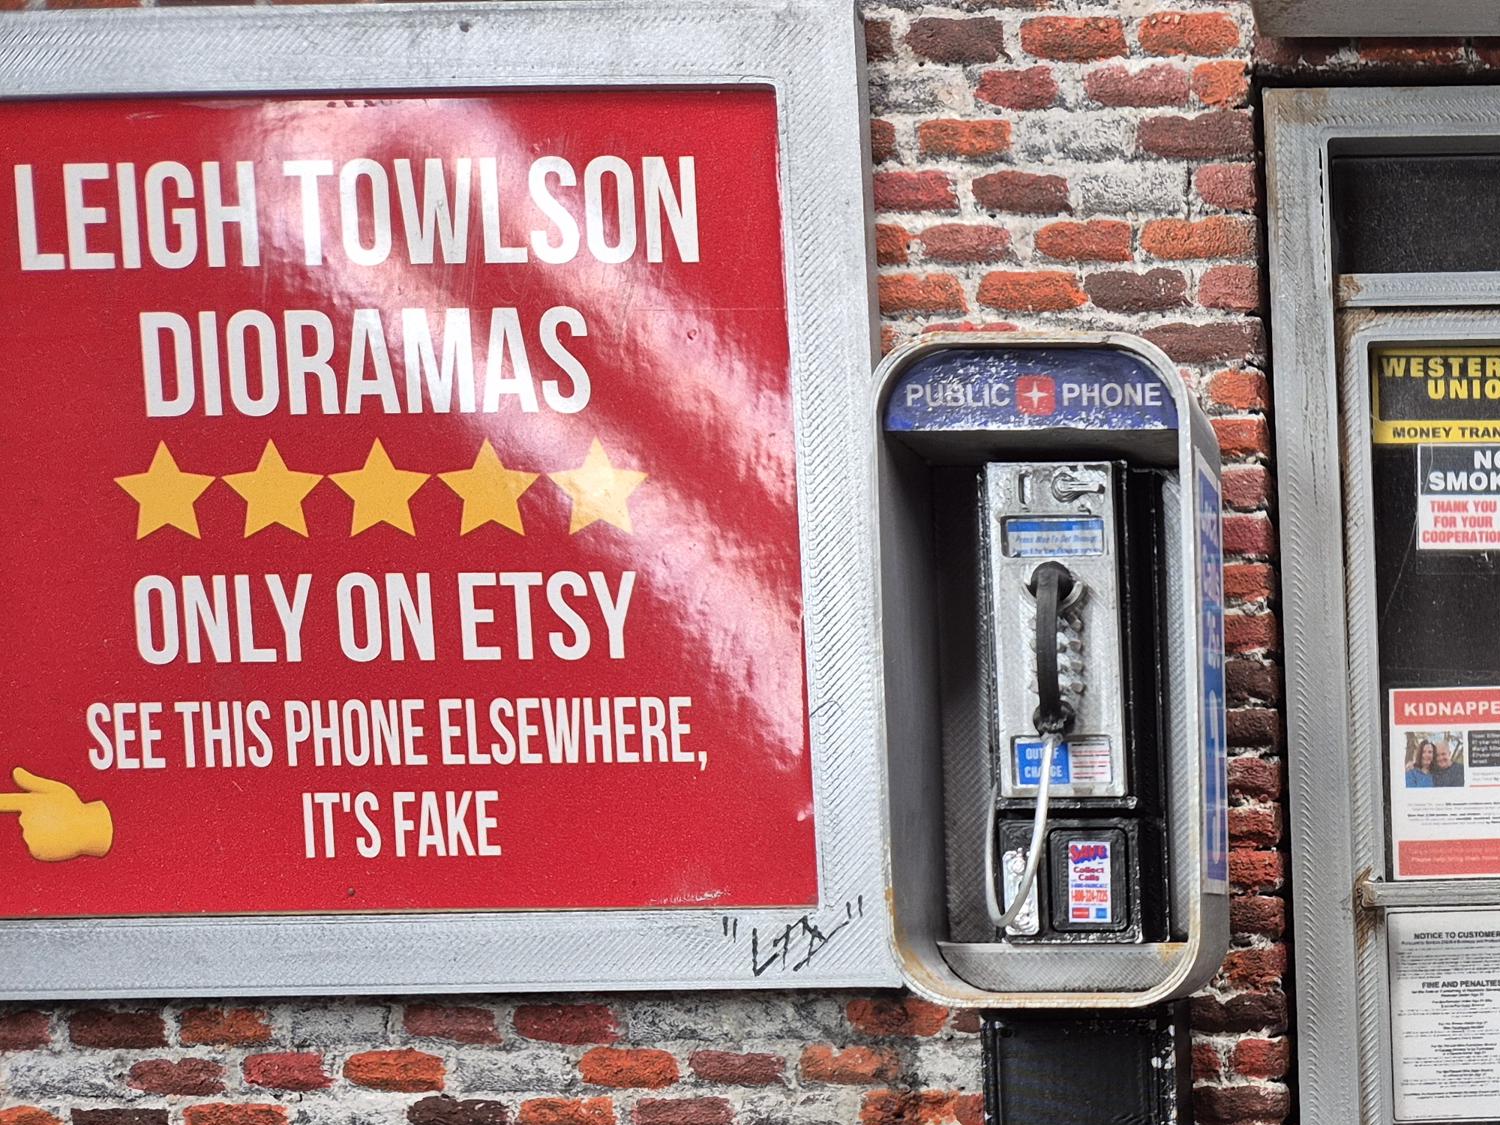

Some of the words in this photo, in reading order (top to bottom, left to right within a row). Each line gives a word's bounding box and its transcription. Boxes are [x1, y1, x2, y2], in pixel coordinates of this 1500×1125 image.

[13, 160, 259, 271] LEIGH
[282, 156, 701, 266] TOWLSON
[138, 307, 592, 418] DIORAMAS
[905, 383, 1011, 407] PUBLIC
[1062, 383, 1162, 406] PHONE
[1393, 426, 1452, 438] MONEY
[1430, 501, 1469, 513] THANK
[1474, 500, 1497, 513] YOU
[1434, 516, 1457, 528] FOR
[1460, 516, 1493, 528] YOUR
[133, 573, 313, 665] ONLY
[337, 572, 431, 662] ON
[458, 570, 636, 660] ETSY
[87, 700, 162, 770] SEE
[175, 700, 273, 768] THIS
[285, 698, 425, 767] PHONE
[440, 695, 710, 771] ELSEWHERE,
[302, 792, 382, 859] IT'S
[392, 791, 503, 858] FAKE
[1414, 931, 1444, 940] NOTICE
